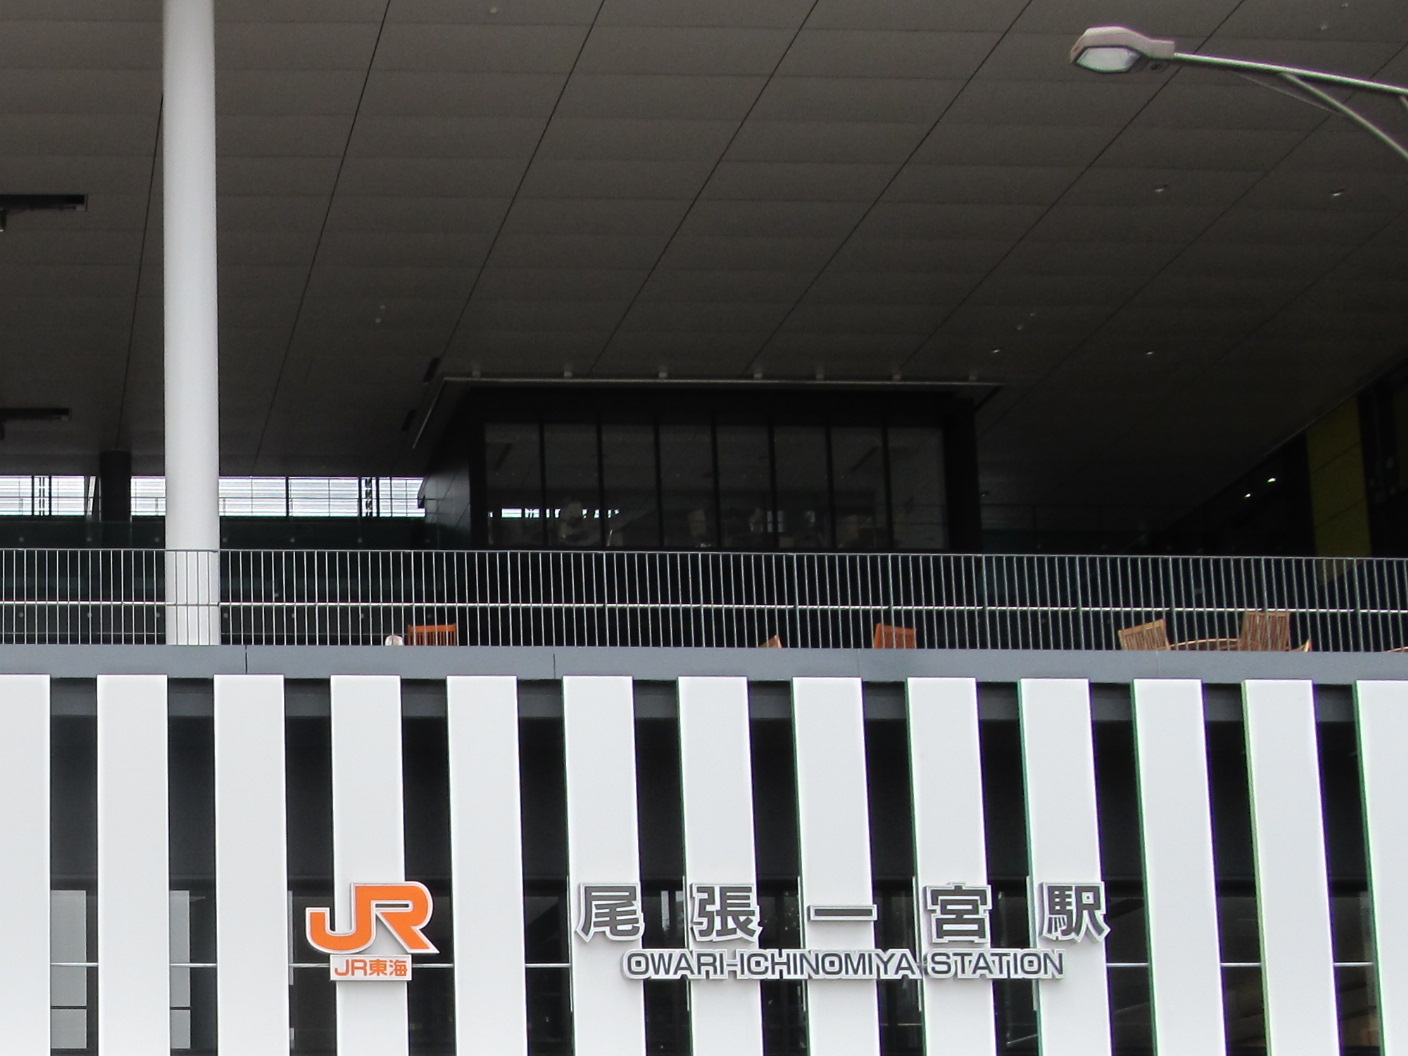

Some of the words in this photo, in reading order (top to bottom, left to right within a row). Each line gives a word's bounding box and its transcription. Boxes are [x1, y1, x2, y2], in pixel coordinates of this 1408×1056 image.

[306, 882, 439, 954] JR
[577, 882, 1110, 942] 尾張一宮駅
[334, 959, 408, 976] JR東海
[623, 950, 922, 978] OWARI-ICHINOMIYA
[928, 950, 1065, 978] STATION
